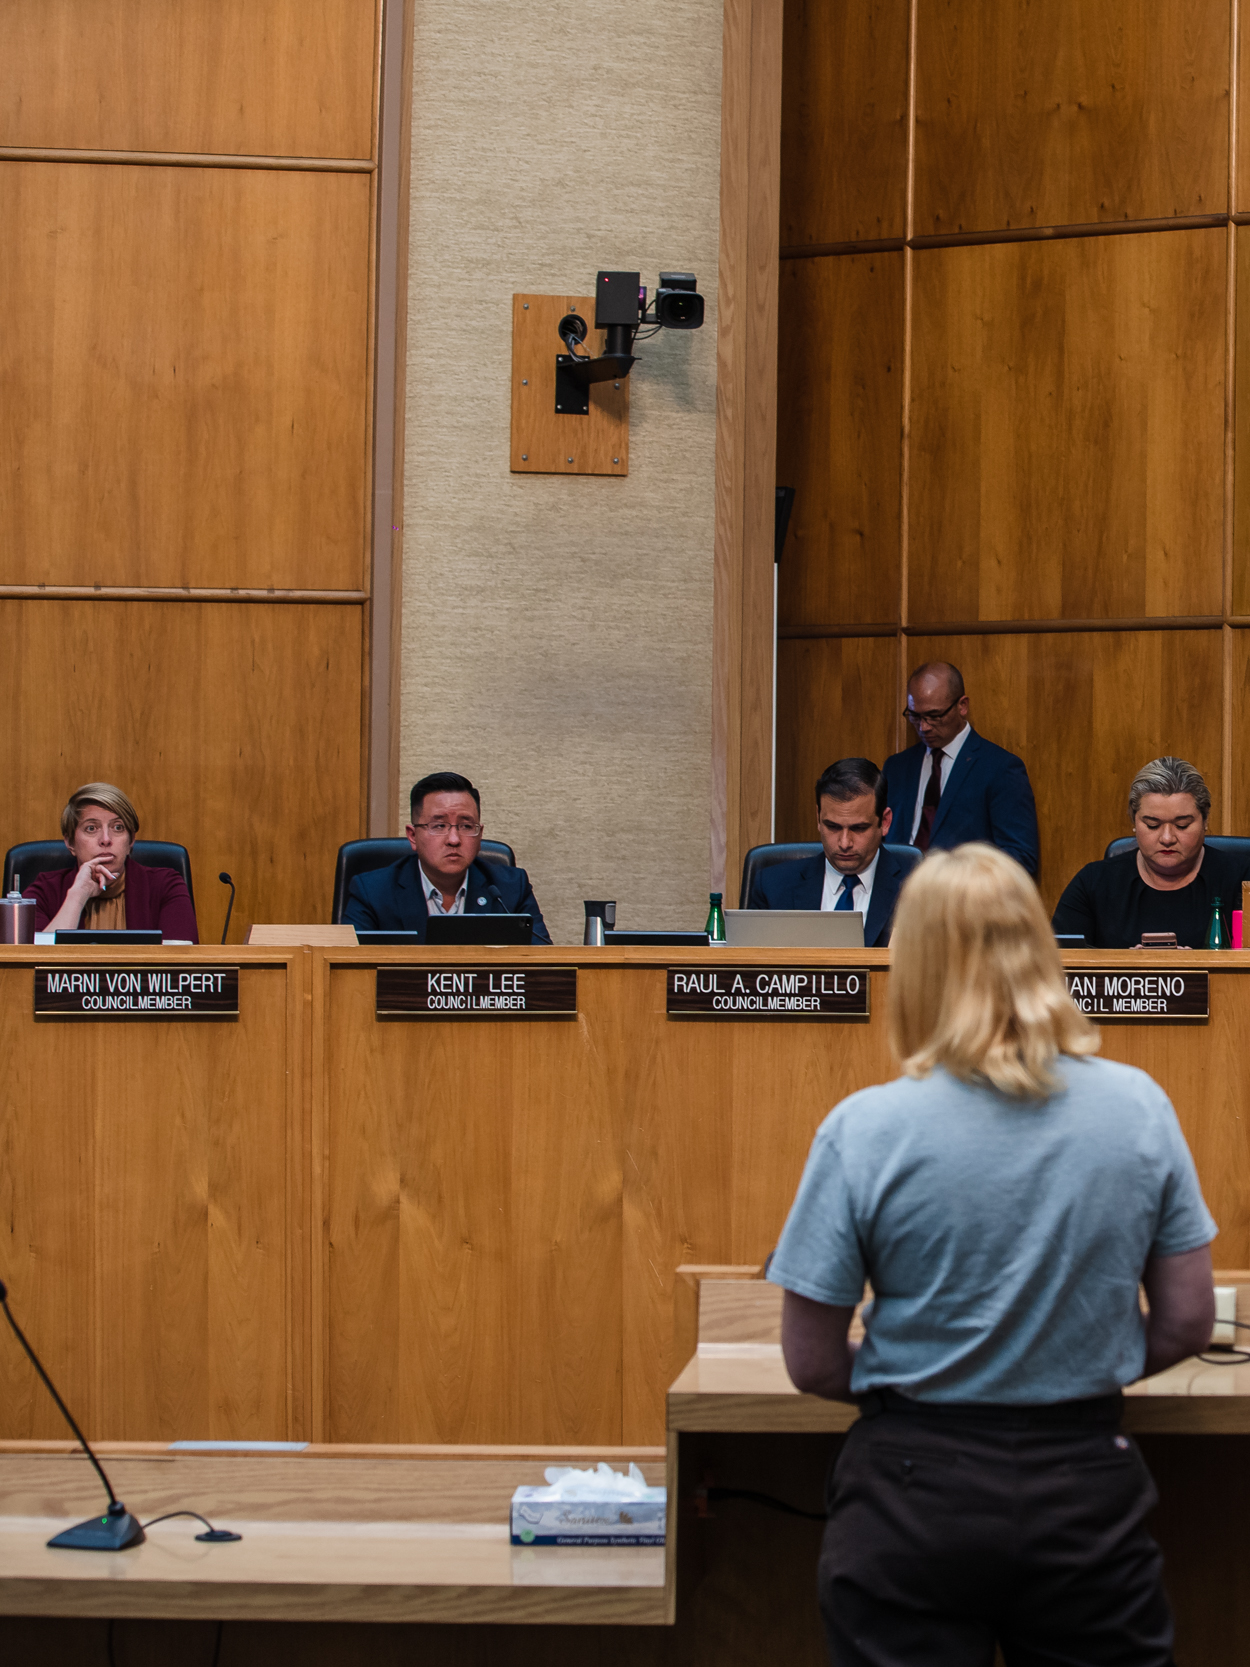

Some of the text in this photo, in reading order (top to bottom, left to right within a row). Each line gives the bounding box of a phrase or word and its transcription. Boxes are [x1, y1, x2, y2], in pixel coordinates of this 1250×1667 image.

[47, 973, 226, 993] MARNI VON WILPERT
[427, 973, 526, 992] KENT LEE
[673, 974, 860, 994] RAUL A. CAMPILLO
[1065, 976, 1185, 997] IAN MORENO
[82, 996, 192, 1009] COUNCILMEMBER
[427, 995, 526, 1009] COUNCILMEMBER
[712, 996, 821, 1010] COUNCILMEMBER
[1073, 998, 1168, 1012] NCIL MEMBER
